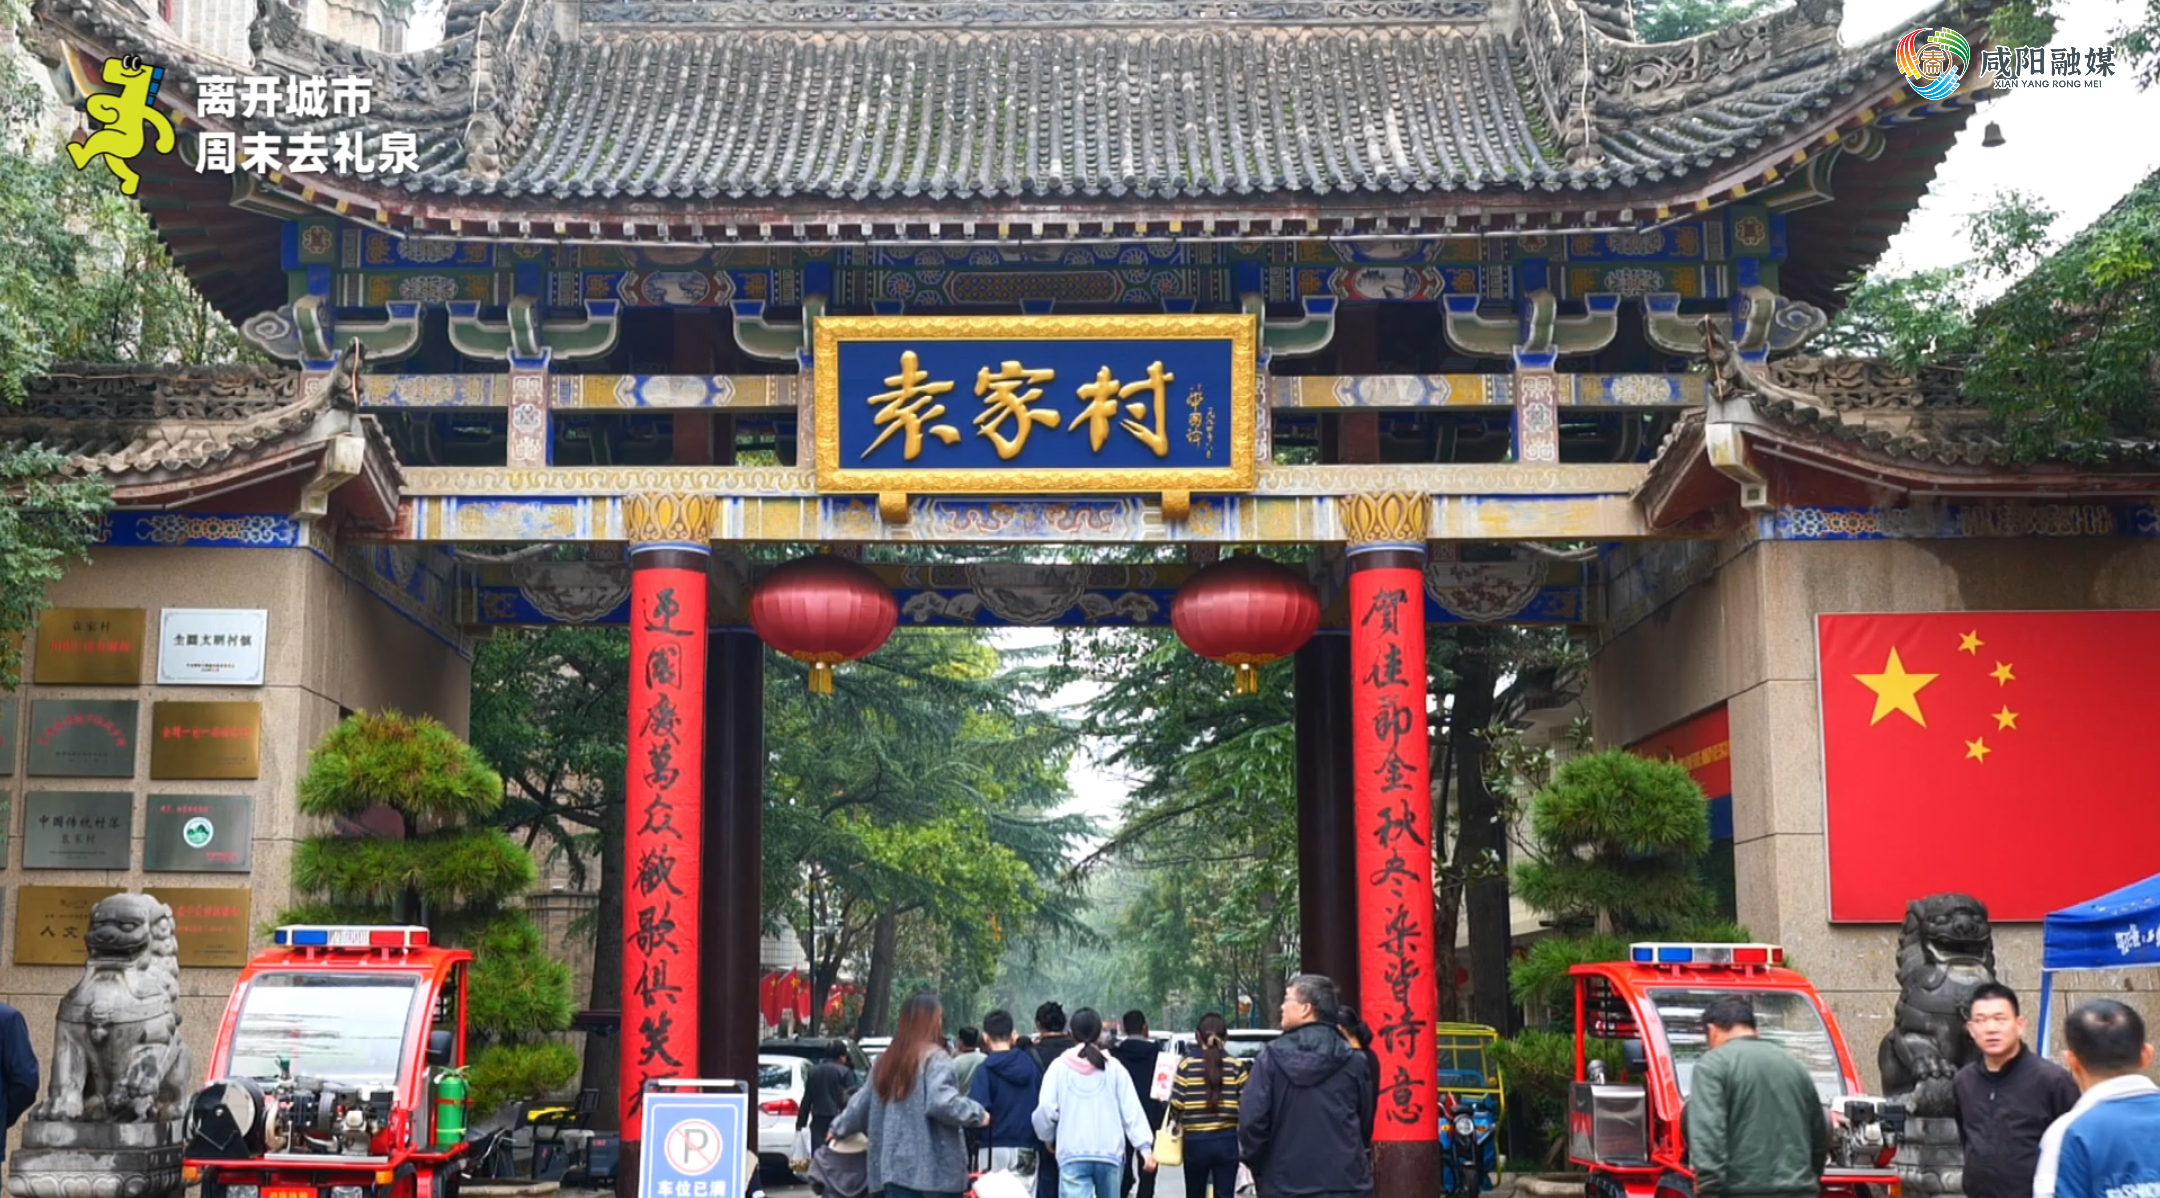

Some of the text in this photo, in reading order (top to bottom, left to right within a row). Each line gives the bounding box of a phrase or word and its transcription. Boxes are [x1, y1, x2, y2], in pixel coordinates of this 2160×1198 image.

[859, 349, 1176, 461] 袁家村
[657, 1181, 727, 1198] 车位已满
